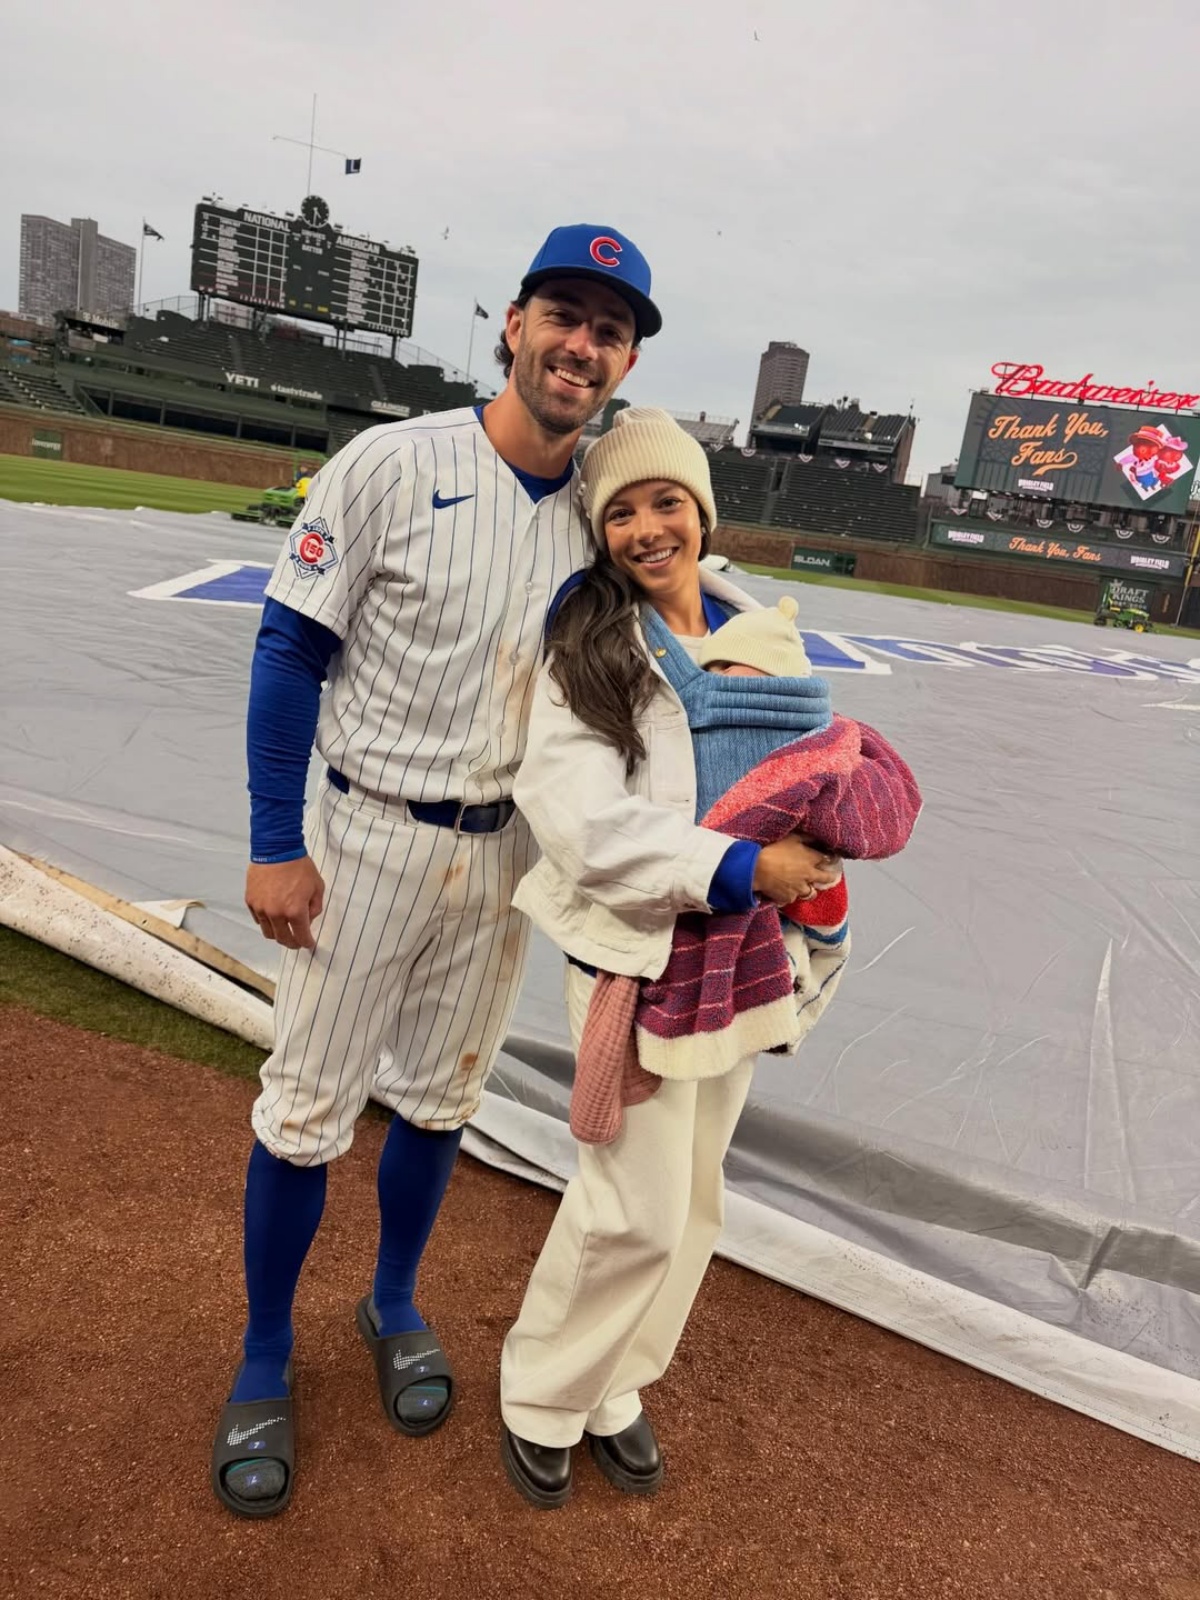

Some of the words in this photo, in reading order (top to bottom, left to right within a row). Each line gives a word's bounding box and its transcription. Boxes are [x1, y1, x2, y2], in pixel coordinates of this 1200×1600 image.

[243, 211, 291, 232] NATIONAL
[335, 235, 380, 254] AMERICAN
[589, 236, 623, 268] C
[225, 372, 260, 389] YETI
[991, 362, 1200, 409] Budweiser
[988, 413, 1060, 440] Thank
[1063, 412, 1109, 443] You,
[1011, 441, 1075, 470] Fans
[305, 541, 324, 558] 150
[1008, 536, 1045, 554] Thank
[1046, 541, 1070, 559] You,
[1072, 545, 1102, 562] Fans
[793, 555, 831, 567] SLOAN
[1110, 585, 1150, 597] DRAFT
[1112, 593, 1146, 604] KINGS
